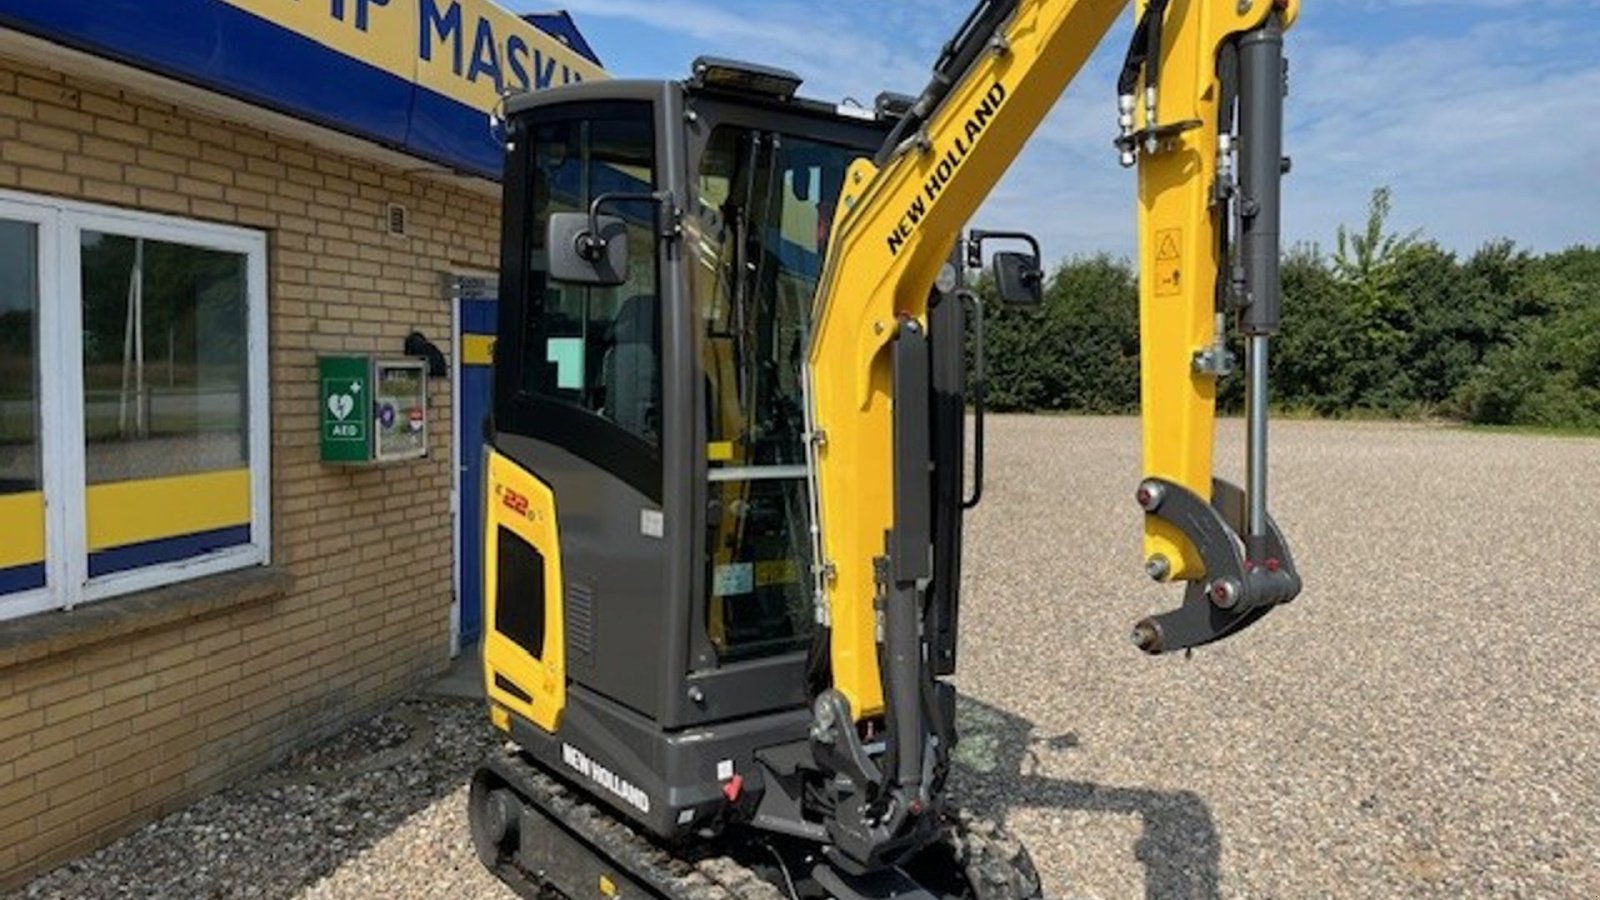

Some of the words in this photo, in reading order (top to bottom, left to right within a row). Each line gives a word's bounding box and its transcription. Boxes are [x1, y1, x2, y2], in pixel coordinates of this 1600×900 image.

[887, 196, 926, 256] NEW
[924, 81, 1006, 201] HOLLAND
[332, 425, 358, 436] AED
[562, 742, 590, 777] NEW
[592, 760, 650, 814] HOLLAND
